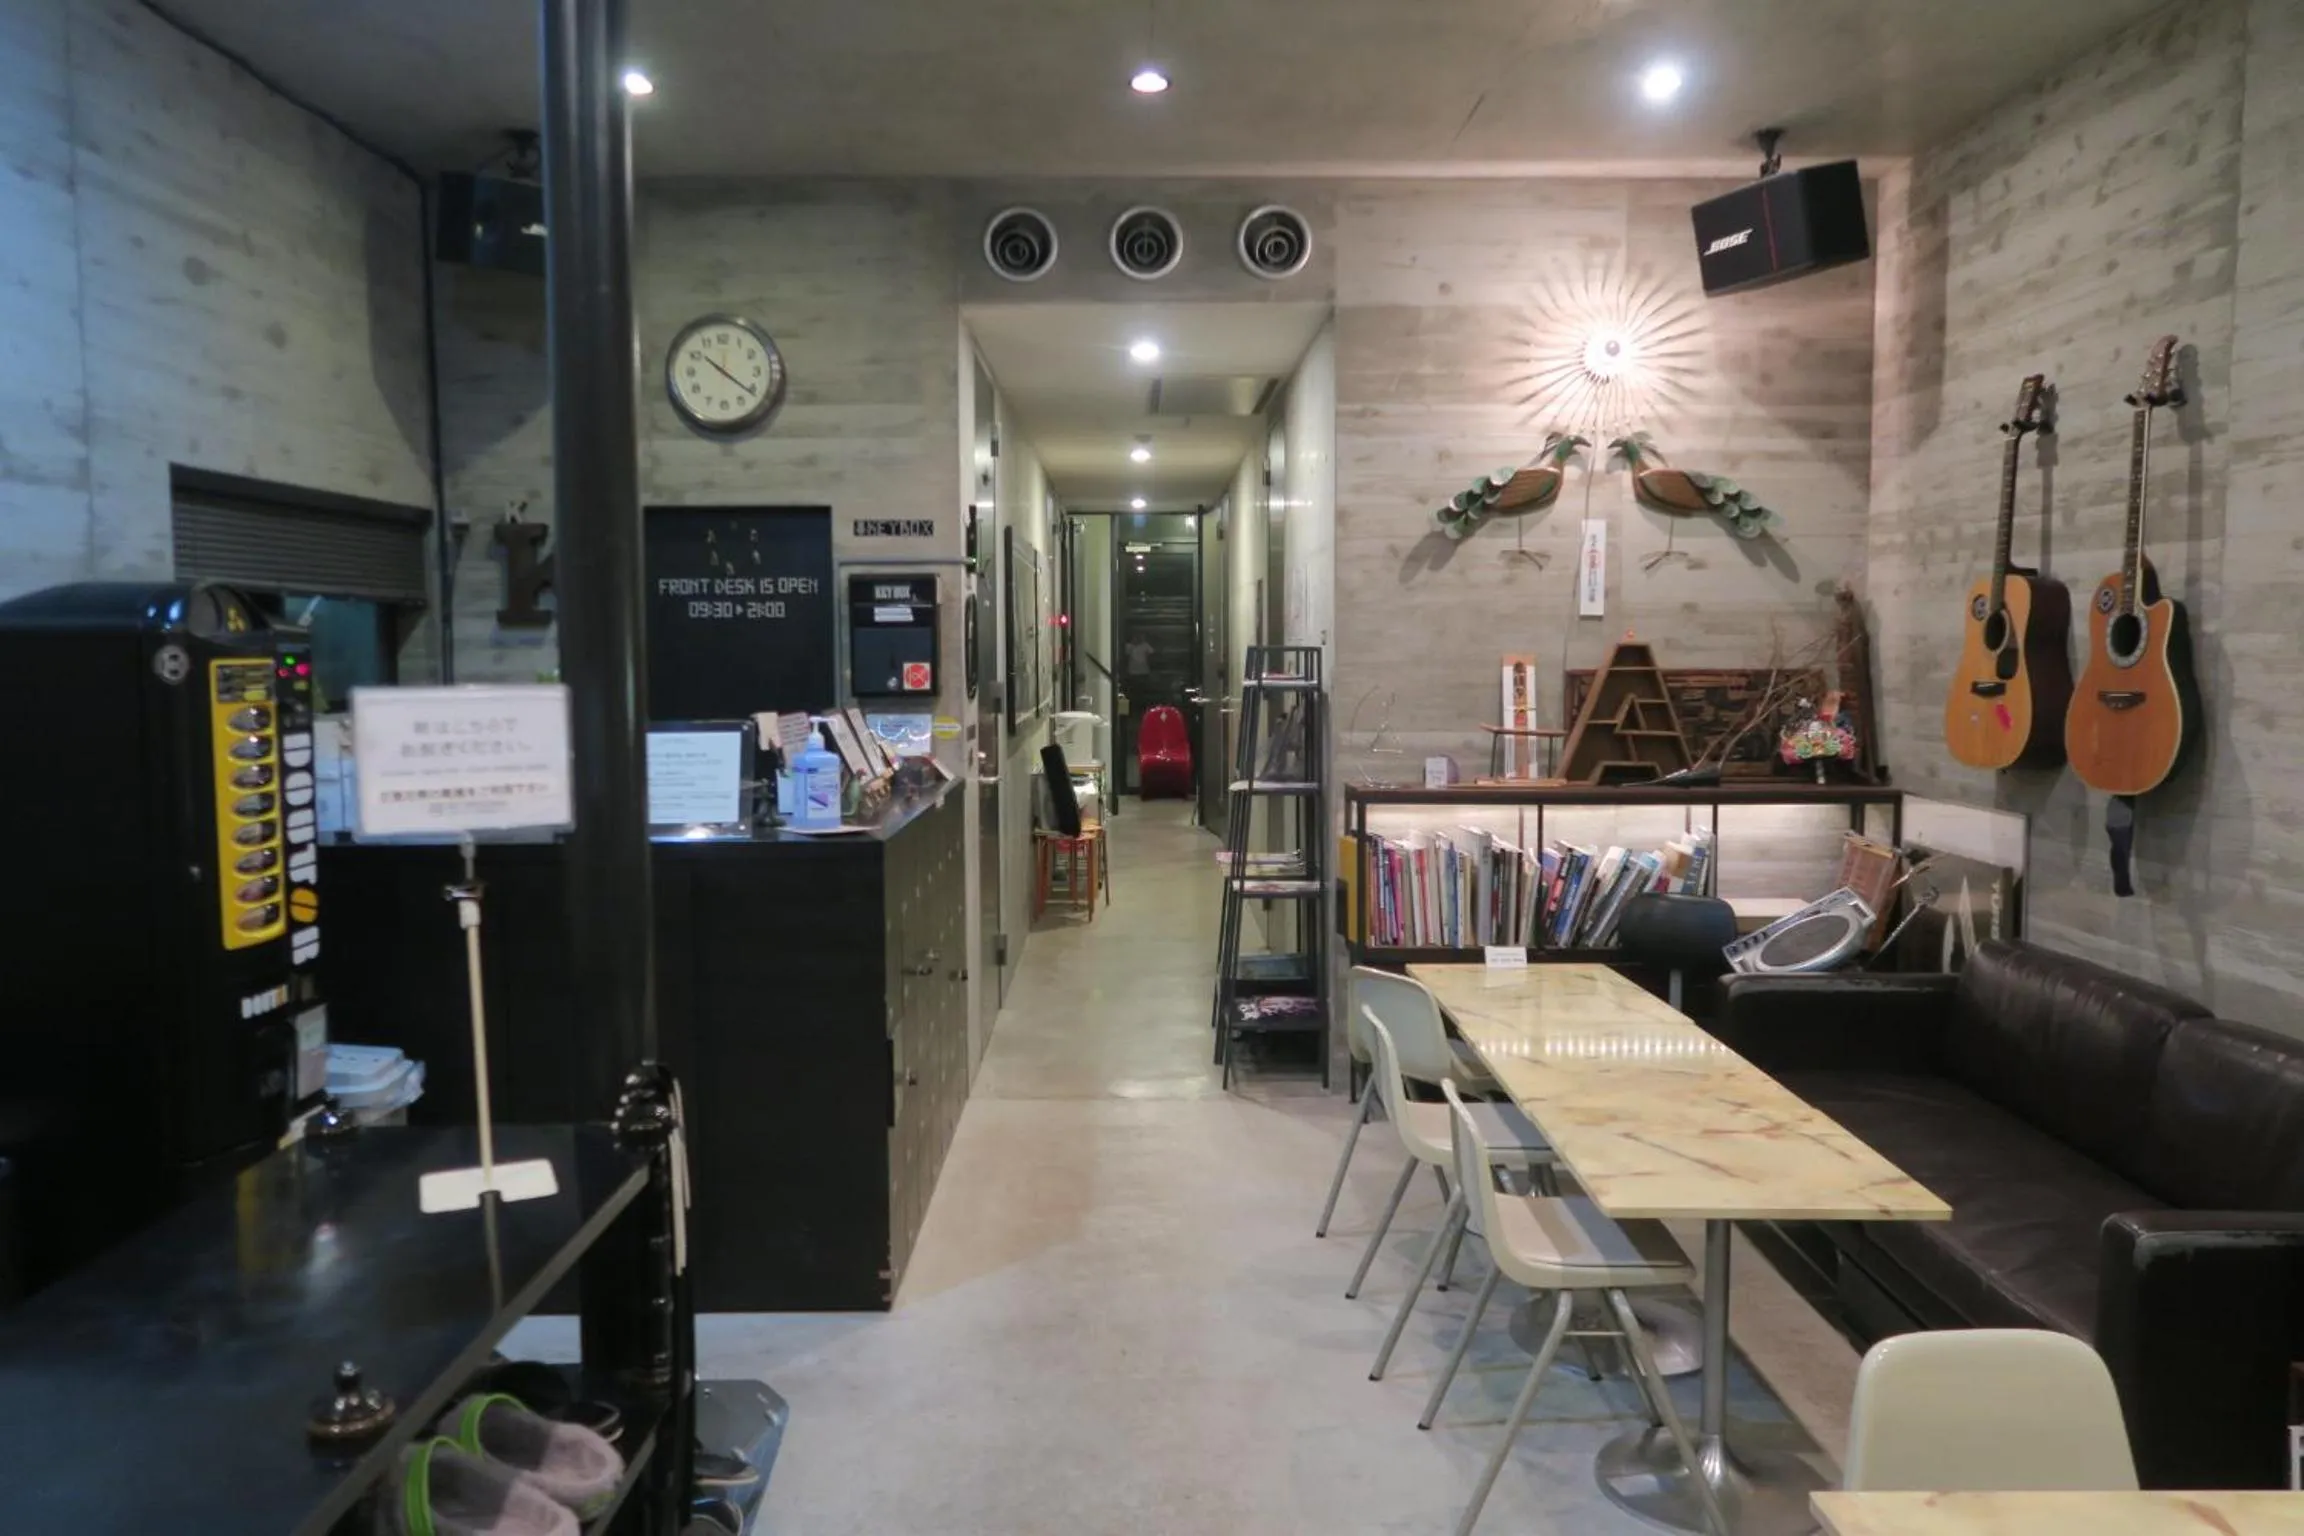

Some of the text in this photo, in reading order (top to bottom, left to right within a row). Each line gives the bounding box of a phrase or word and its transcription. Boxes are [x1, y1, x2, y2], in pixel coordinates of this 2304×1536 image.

[1703, 228, 1754, 256] BOSE
[658, 577, 819, 596] FRONT DESK IS OPEN
